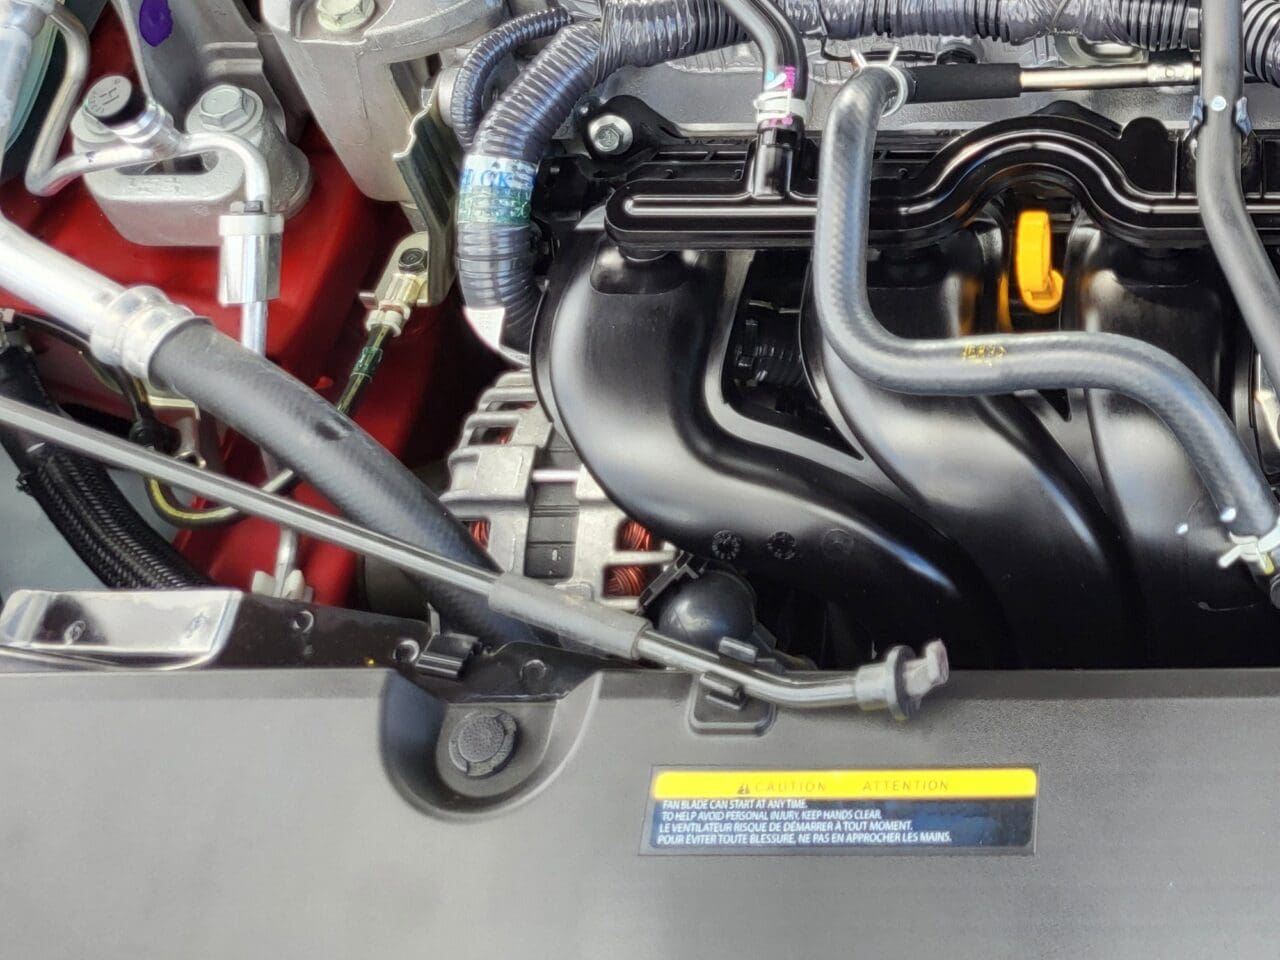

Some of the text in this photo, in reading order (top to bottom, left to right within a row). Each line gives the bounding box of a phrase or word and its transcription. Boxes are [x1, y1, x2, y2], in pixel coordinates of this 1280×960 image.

[755, 780, 949, 793] CAUTION ATTENTION
[662, 799, 808, 809] FAN BLADE CAN START AT ANY TIME.
[662, 811, 674, 822] TO
[676, 811, 697, 821] HELP
[698, 810, 725, 821] AVOID
[726, 810, 768, 821] PERSONAL
[801, 810, 822, 820] KEEP
[823, 810, 853, 820] HANDS
[854, 809, 882, 819] CLEAR.
[659, 819, 913, 833] LE VENTILATEUR RISQUE DE DÉMARRER À TOUT MOMENT.
[657, 831, 952, 845] POUR ÉVITER TOUTE BLESSURE, NE PAS EN APPROCHER LES MAINS.
